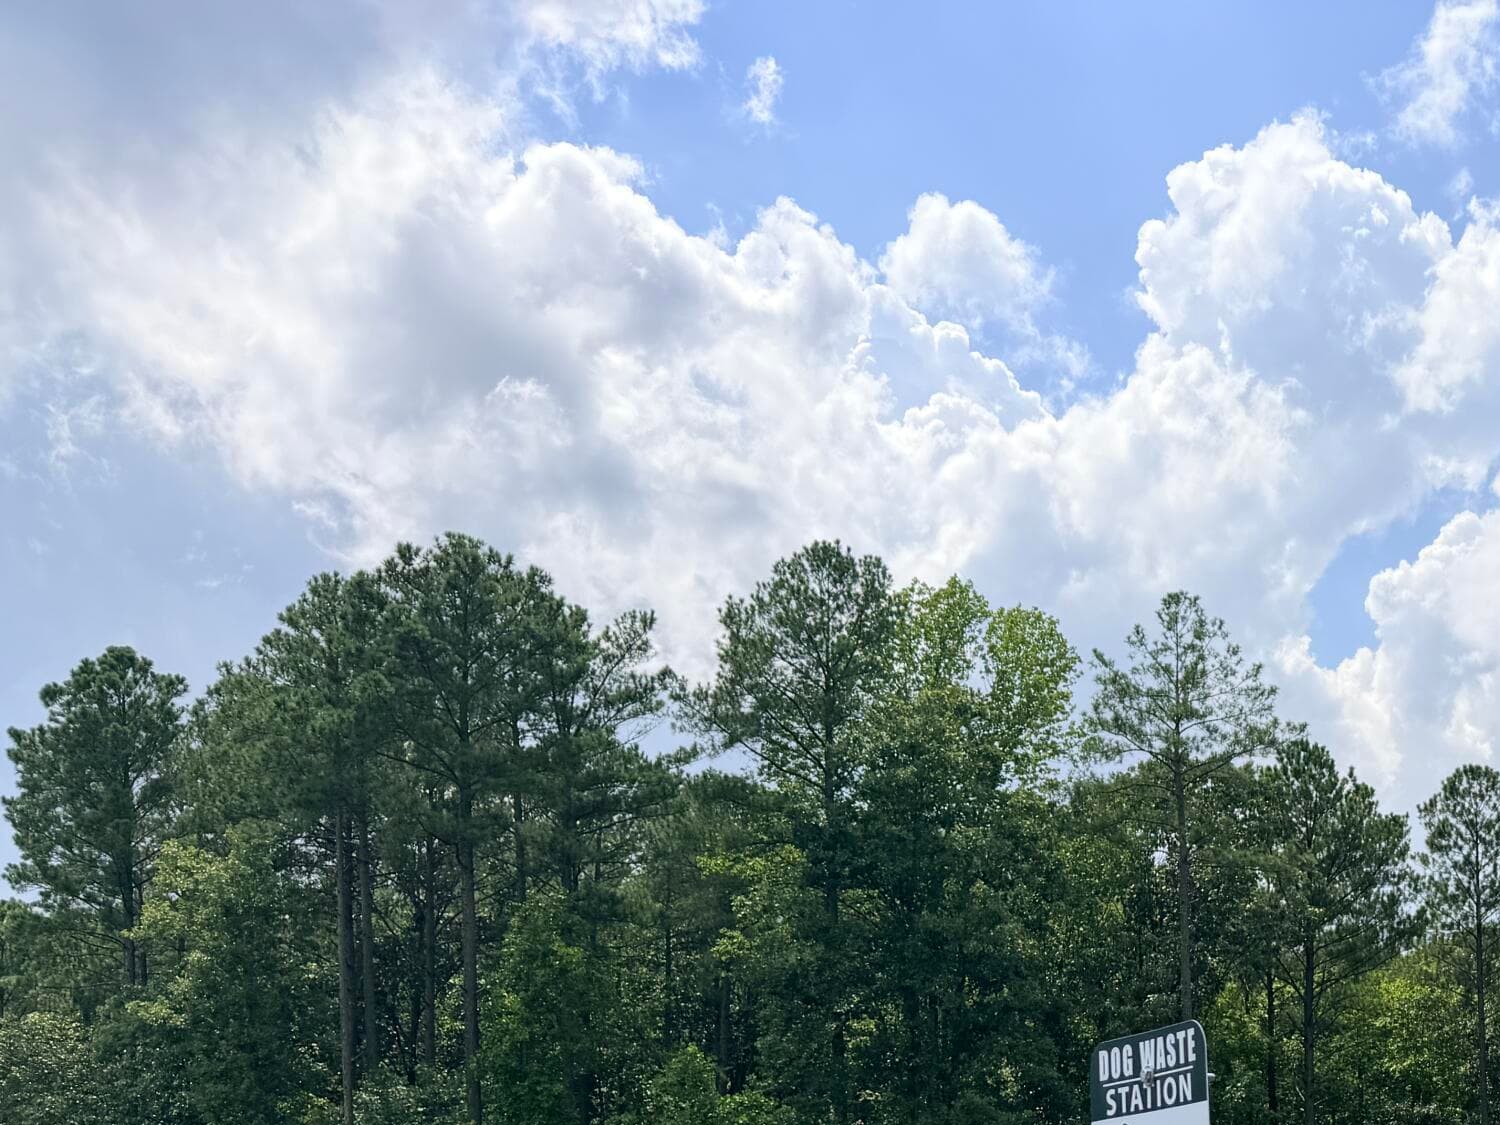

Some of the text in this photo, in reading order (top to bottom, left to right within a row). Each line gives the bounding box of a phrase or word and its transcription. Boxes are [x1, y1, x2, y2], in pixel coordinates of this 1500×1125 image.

[1098, 1028, 1196, 1081] DOG WASTE
[1106, 1073, 1192, 1116] STATION
